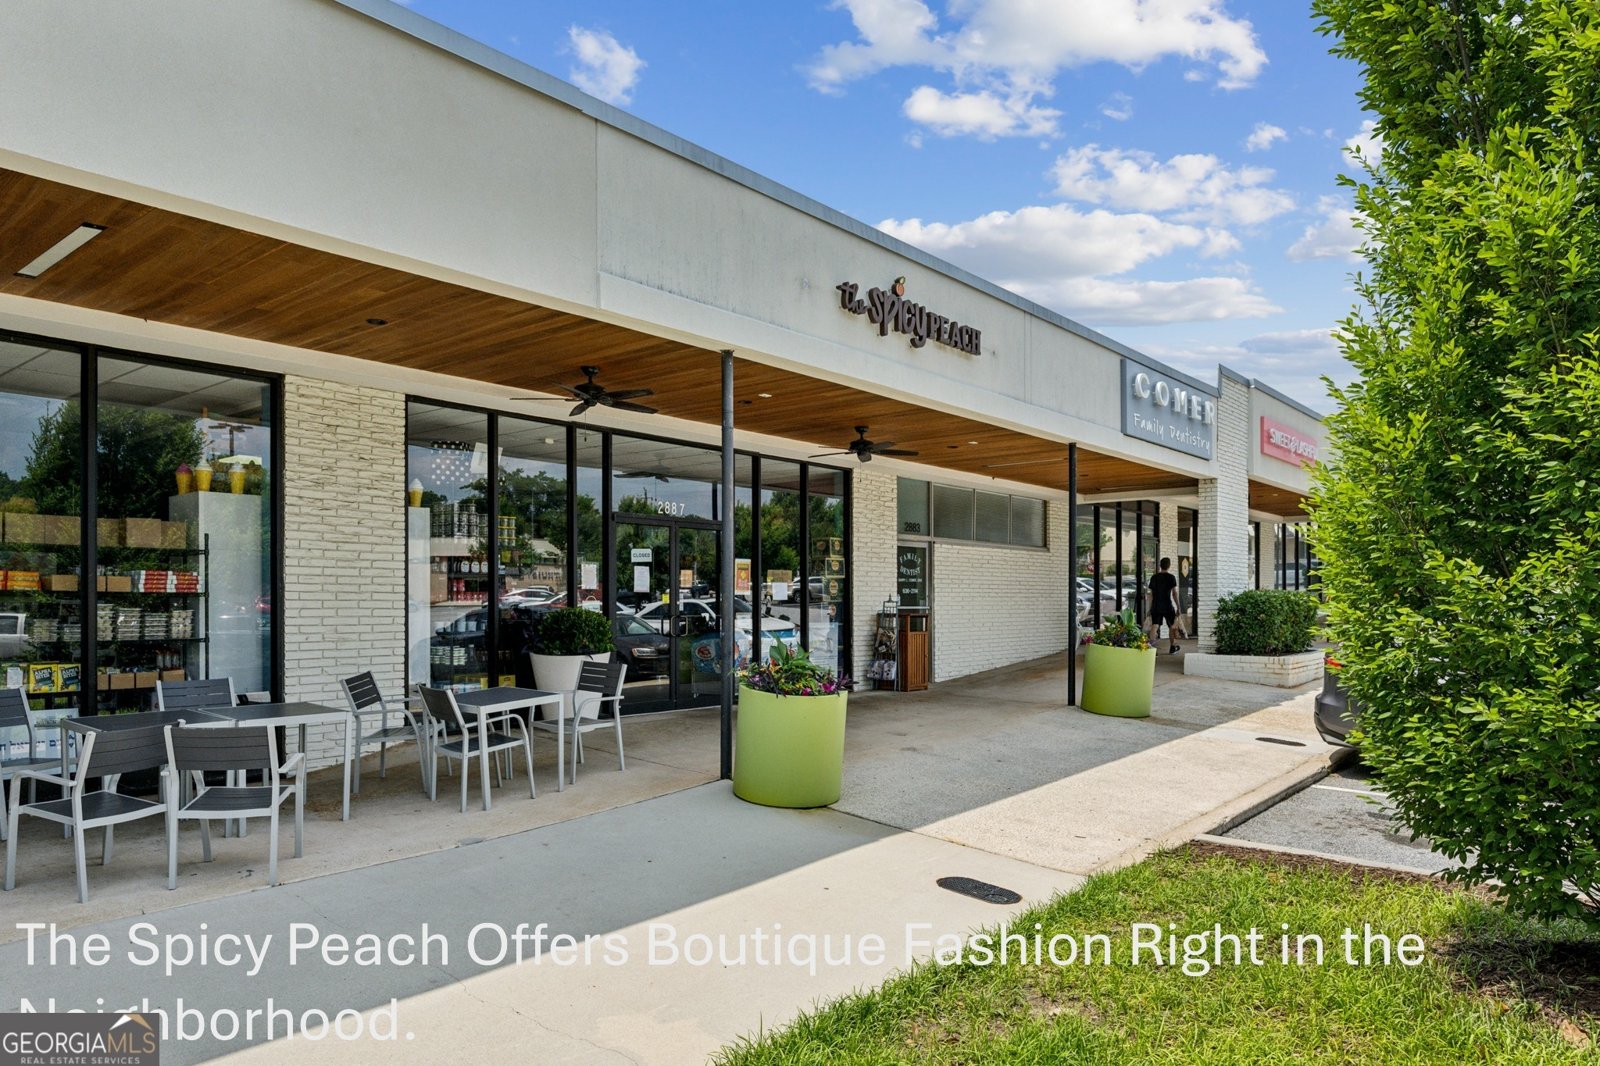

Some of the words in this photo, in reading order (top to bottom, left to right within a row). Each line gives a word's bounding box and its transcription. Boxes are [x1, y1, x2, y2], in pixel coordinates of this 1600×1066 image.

[836, 282, 868, 314] the
[926, 312, 981, 355] PEACH
[1134, 373, 1215, 424] COMER
[1133, 413, 1164, 440] Family
[1169, 425, 1210, 455] Dentistry
[657, 502, 685, 515] 2887
[904, 522, 920, 533] 2883
[899, 552, 921, 564] FAMILY
